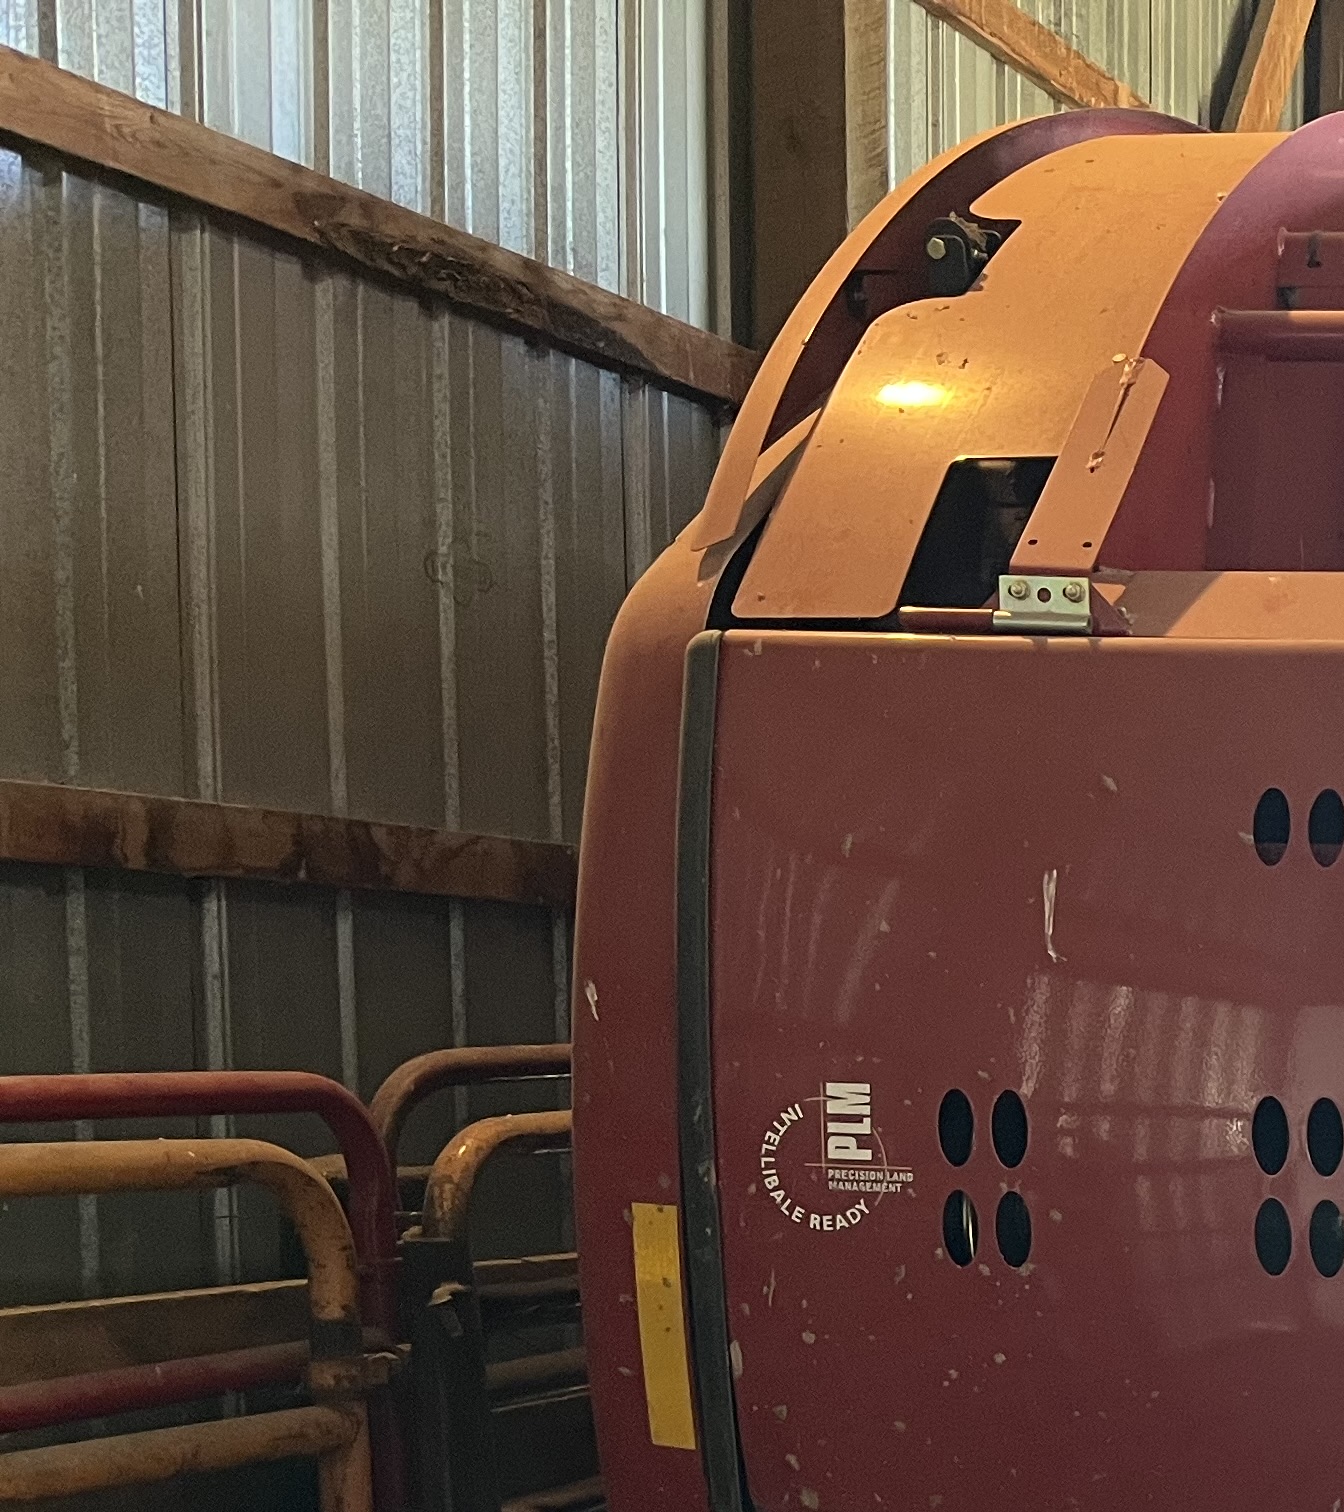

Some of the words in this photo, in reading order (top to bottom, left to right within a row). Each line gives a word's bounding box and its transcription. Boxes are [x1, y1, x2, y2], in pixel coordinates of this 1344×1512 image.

[825, 1081, 873, 1161] PLM
[760, 1103, 806, 1224] INTELLIBALE
[809, 1198, 870, 1232] READY
[827, 1169, 884, 1182] PRECISION
[886, 1171, 914, 1183] LAND
[828, 1181, 902, 1193] MANAGEMENT
